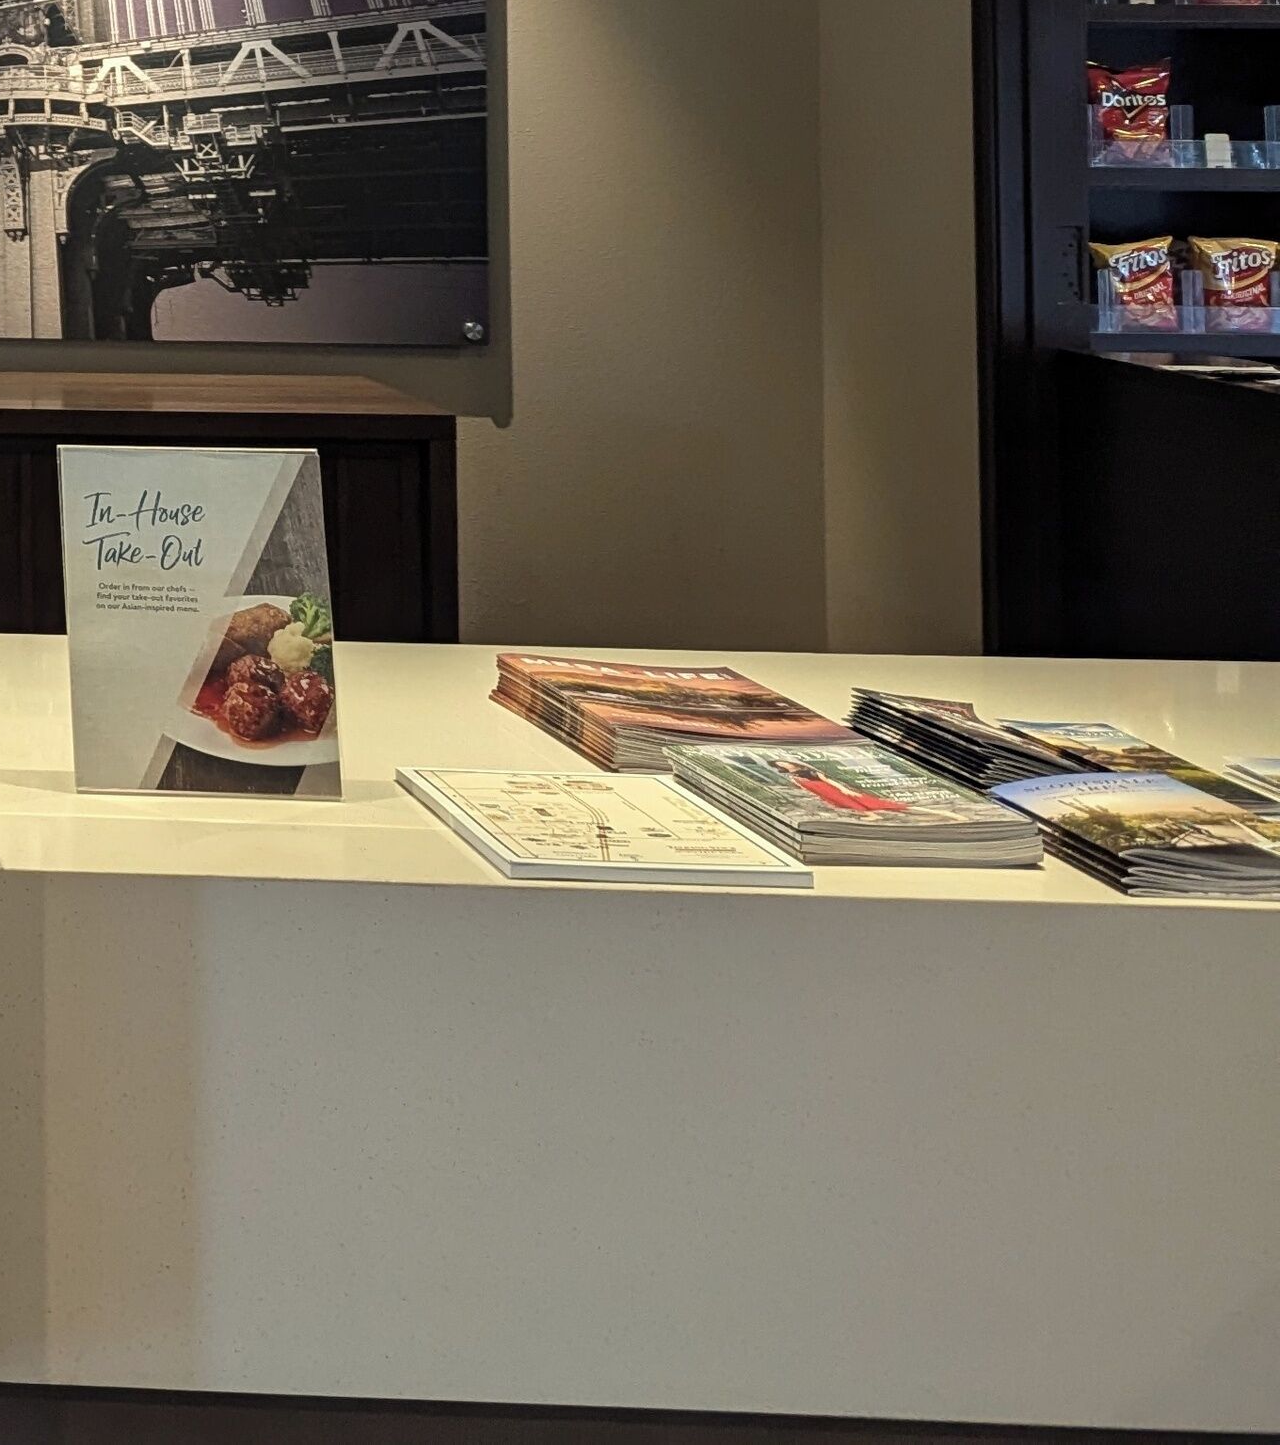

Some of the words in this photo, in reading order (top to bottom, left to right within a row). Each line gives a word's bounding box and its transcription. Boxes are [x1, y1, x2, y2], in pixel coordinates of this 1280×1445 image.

[1102, 91, 1166, 107] Doritos
[1109, 248, 1168, 278] Fritos
[1211, 249, 1272, 279] Fritos
[83, 490, 206, 531] In-House
[82, 532, 204, 570] Take-Out
[98, 582, 122, 590] Order
[96, 592, 111, 600] find
[132, 593, 163, 601] take-out
[165, 595, 198, 603] favorites
[122, 603, 174, 612] Asian-inspired
[521, 657, 623, 675] MESA
